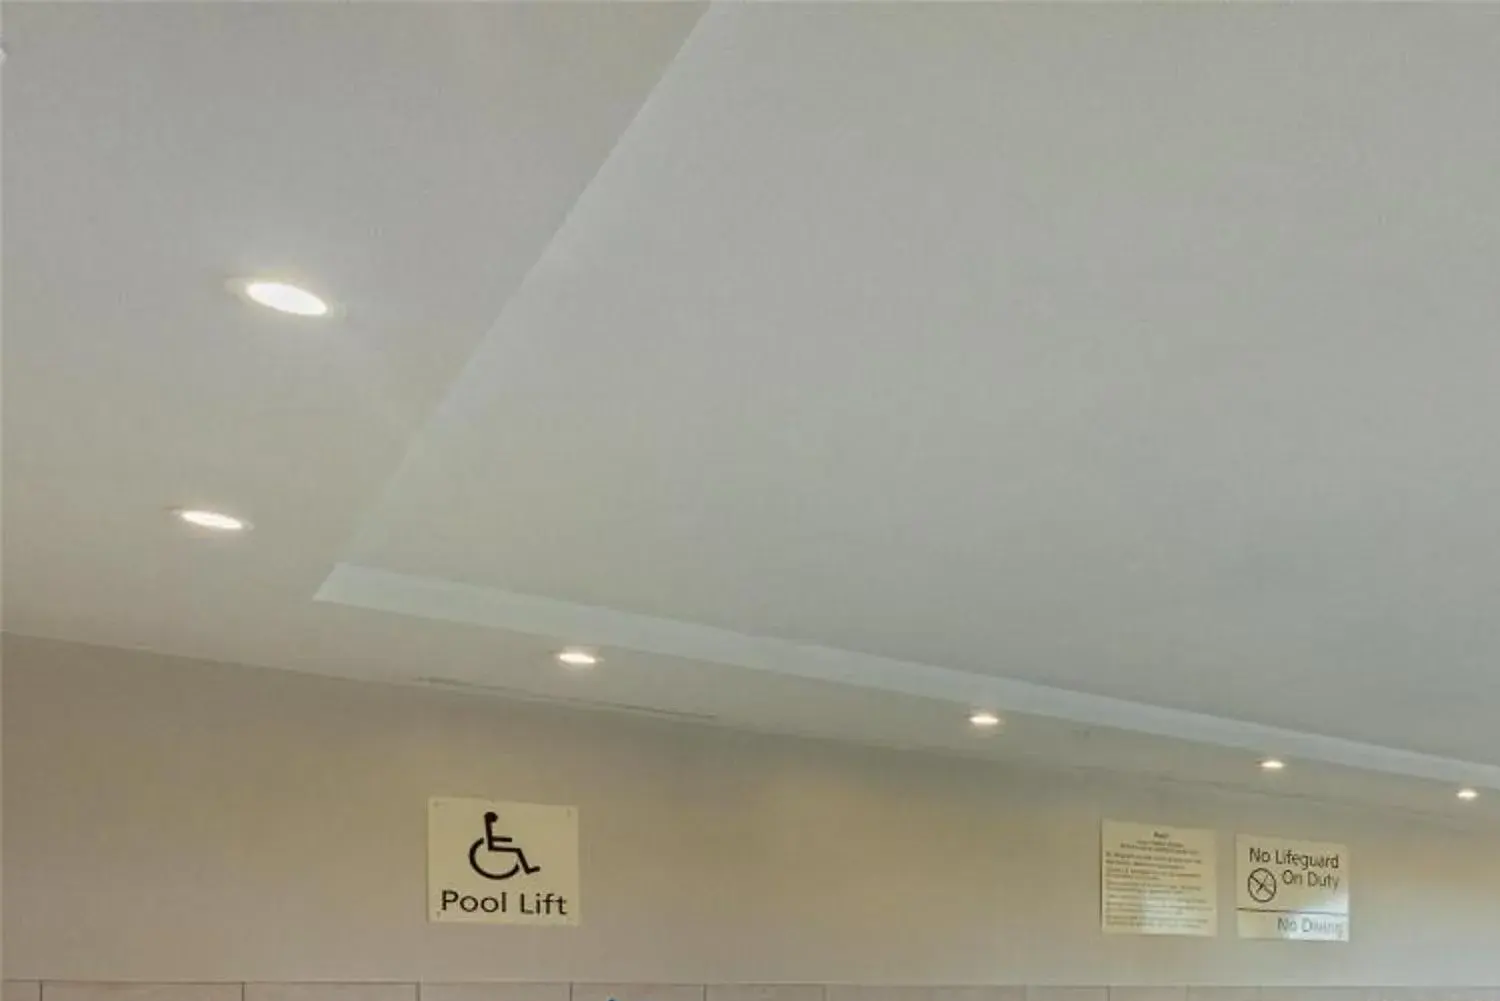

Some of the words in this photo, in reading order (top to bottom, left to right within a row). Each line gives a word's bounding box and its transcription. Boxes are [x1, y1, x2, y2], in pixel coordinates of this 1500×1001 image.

[1249, 847, 1271, 863] No
[1275, 849, 1339, 870] Lifeguard
[1282, 869, 1302, 885] On
[1307, 871, 1340, 893] Duty
[441, 889, 507, 913] Pool
[519, 893, 568, 915] Lift
[1277, 917, 1297, 932] No
